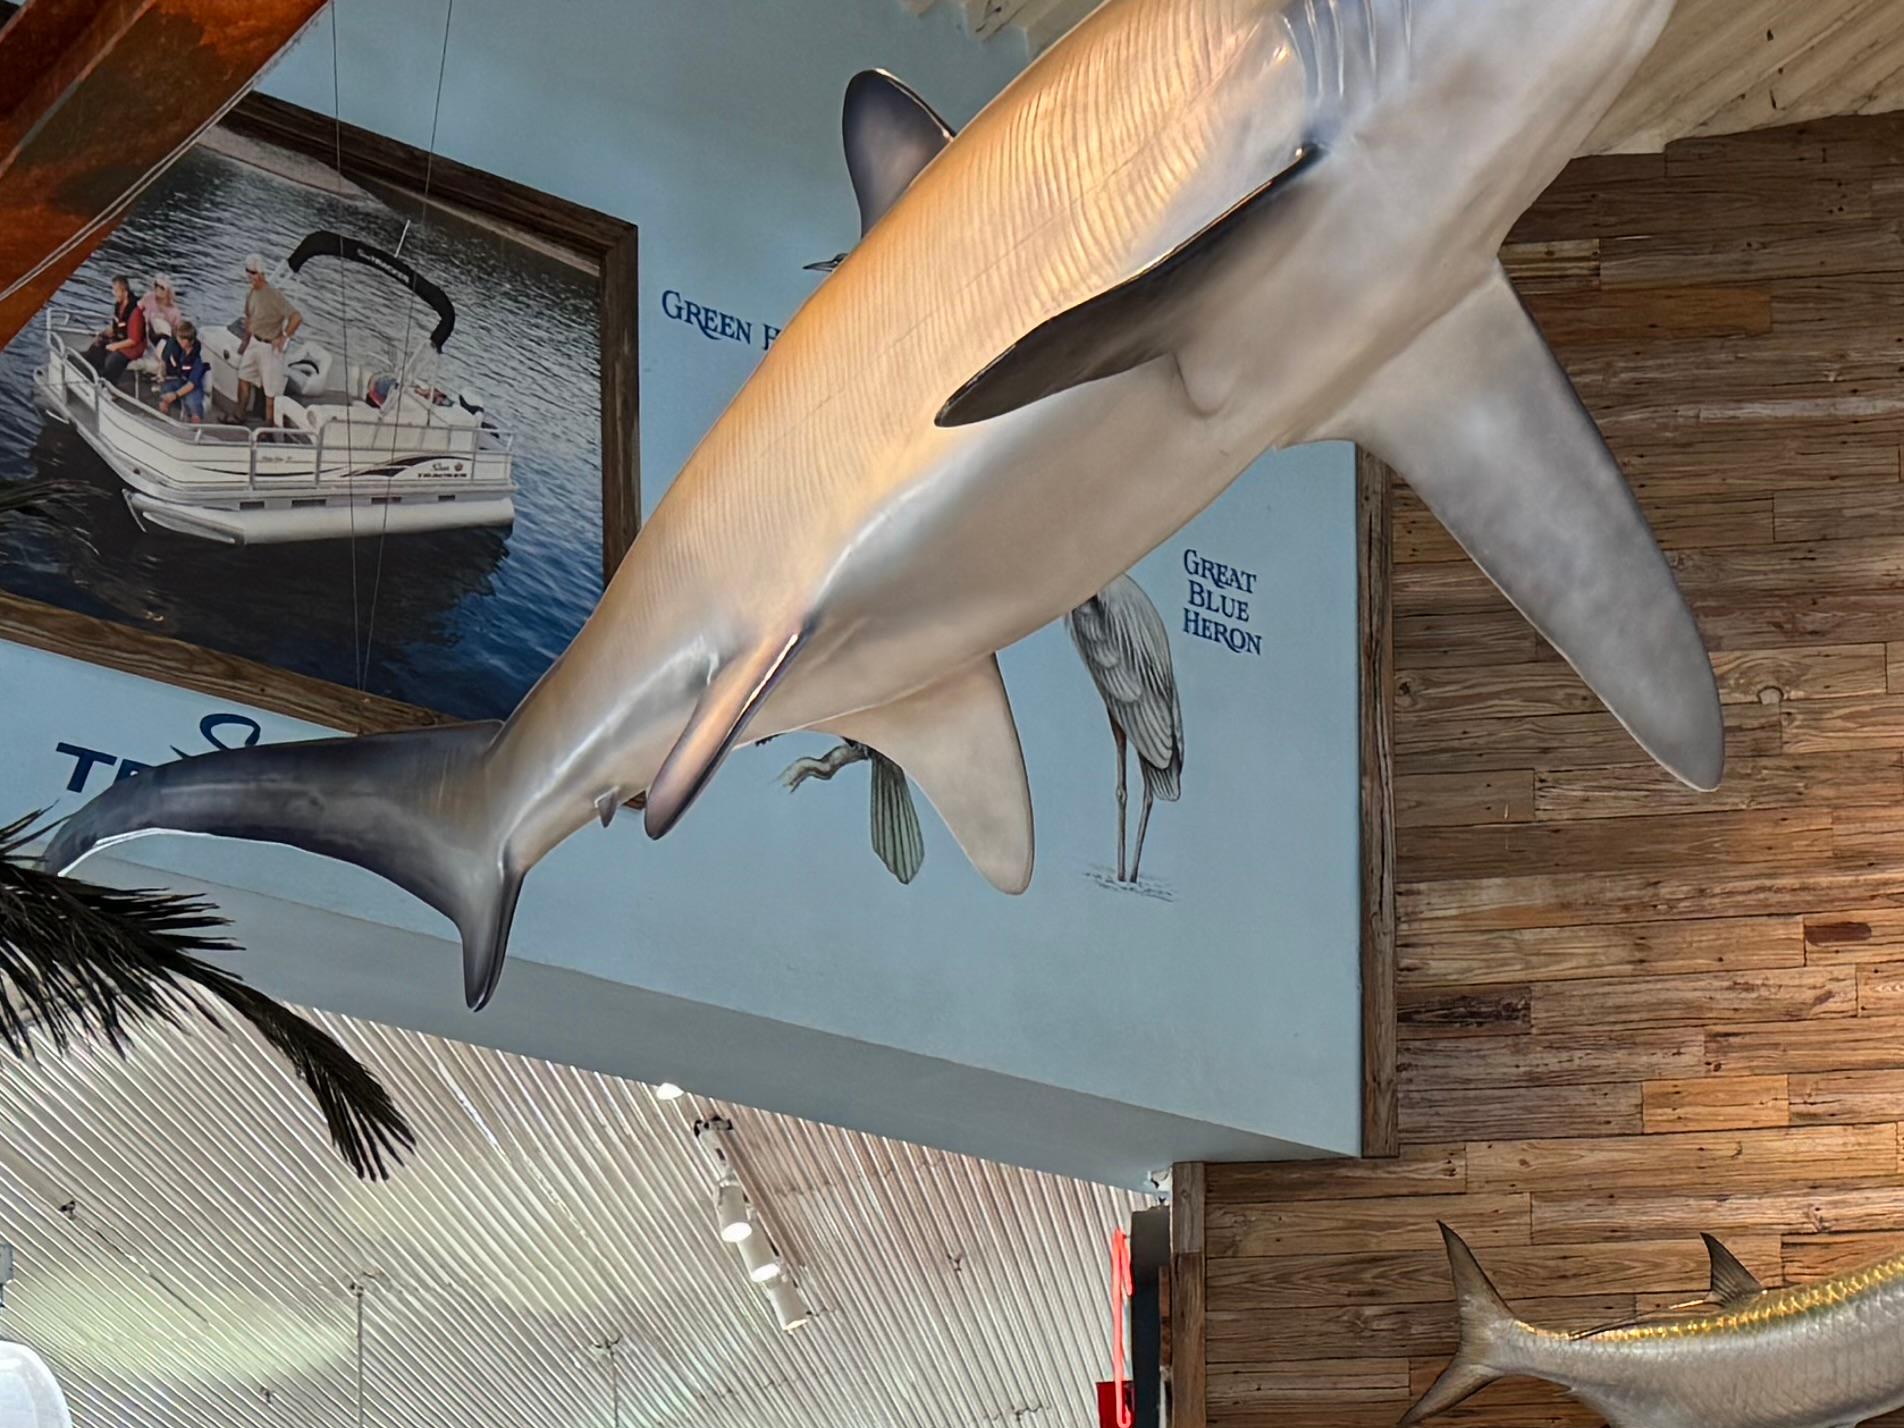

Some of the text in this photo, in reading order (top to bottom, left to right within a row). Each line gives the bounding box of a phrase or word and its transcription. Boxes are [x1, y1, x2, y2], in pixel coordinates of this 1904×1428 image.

[662, 290, 752, 344] GREEN
[1184, 549, 1257, 594] GREAT
[1188, 579, 1249, 622] BLUE
[1182, 607, 1263, 655] HERON
